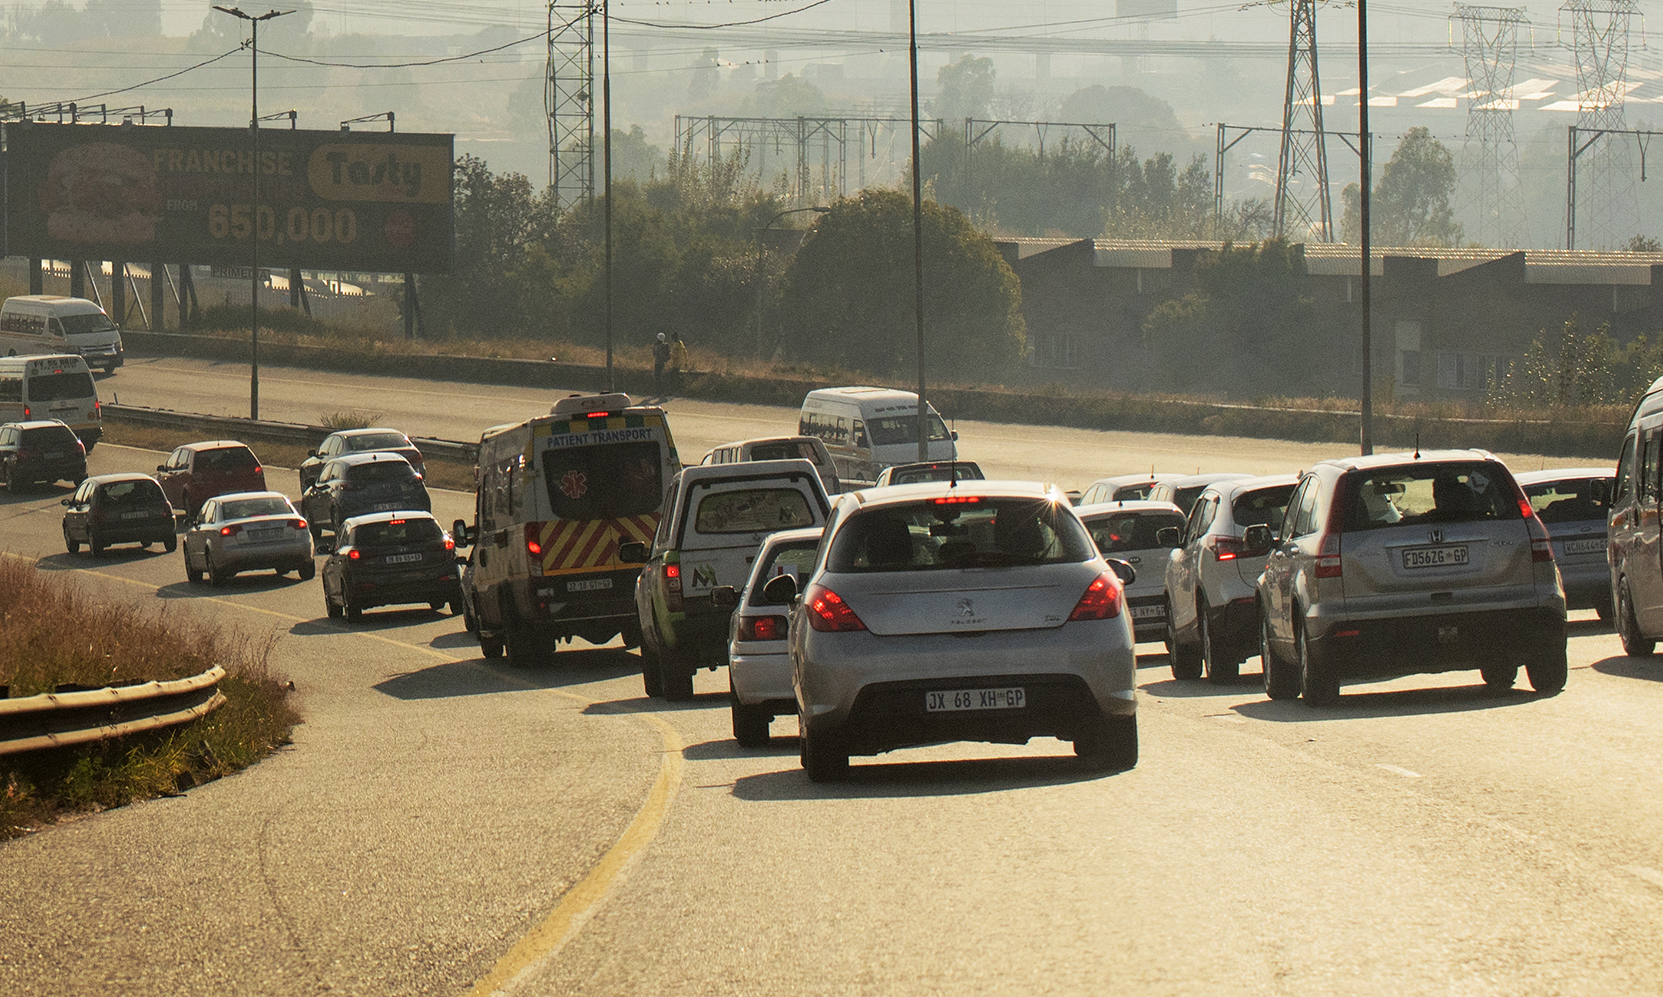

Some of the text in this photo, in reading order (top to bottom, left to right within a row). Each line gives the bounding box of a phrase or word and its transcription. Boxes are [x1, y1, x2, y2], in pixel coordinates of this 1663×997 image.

[153, 149, 293, 176] FRANCHISE
[326, 152, 421, 198] Tasty
[167, 199, 198, 211] FROM
[208, 204, 357, 245] 650,000
[547, 429, 652, 447] PATIENT TRANSPORT
[1405, 549, 1467, 565] FD56ZG GP
[929, 690, 1023, 709] JX 68 XH GP
